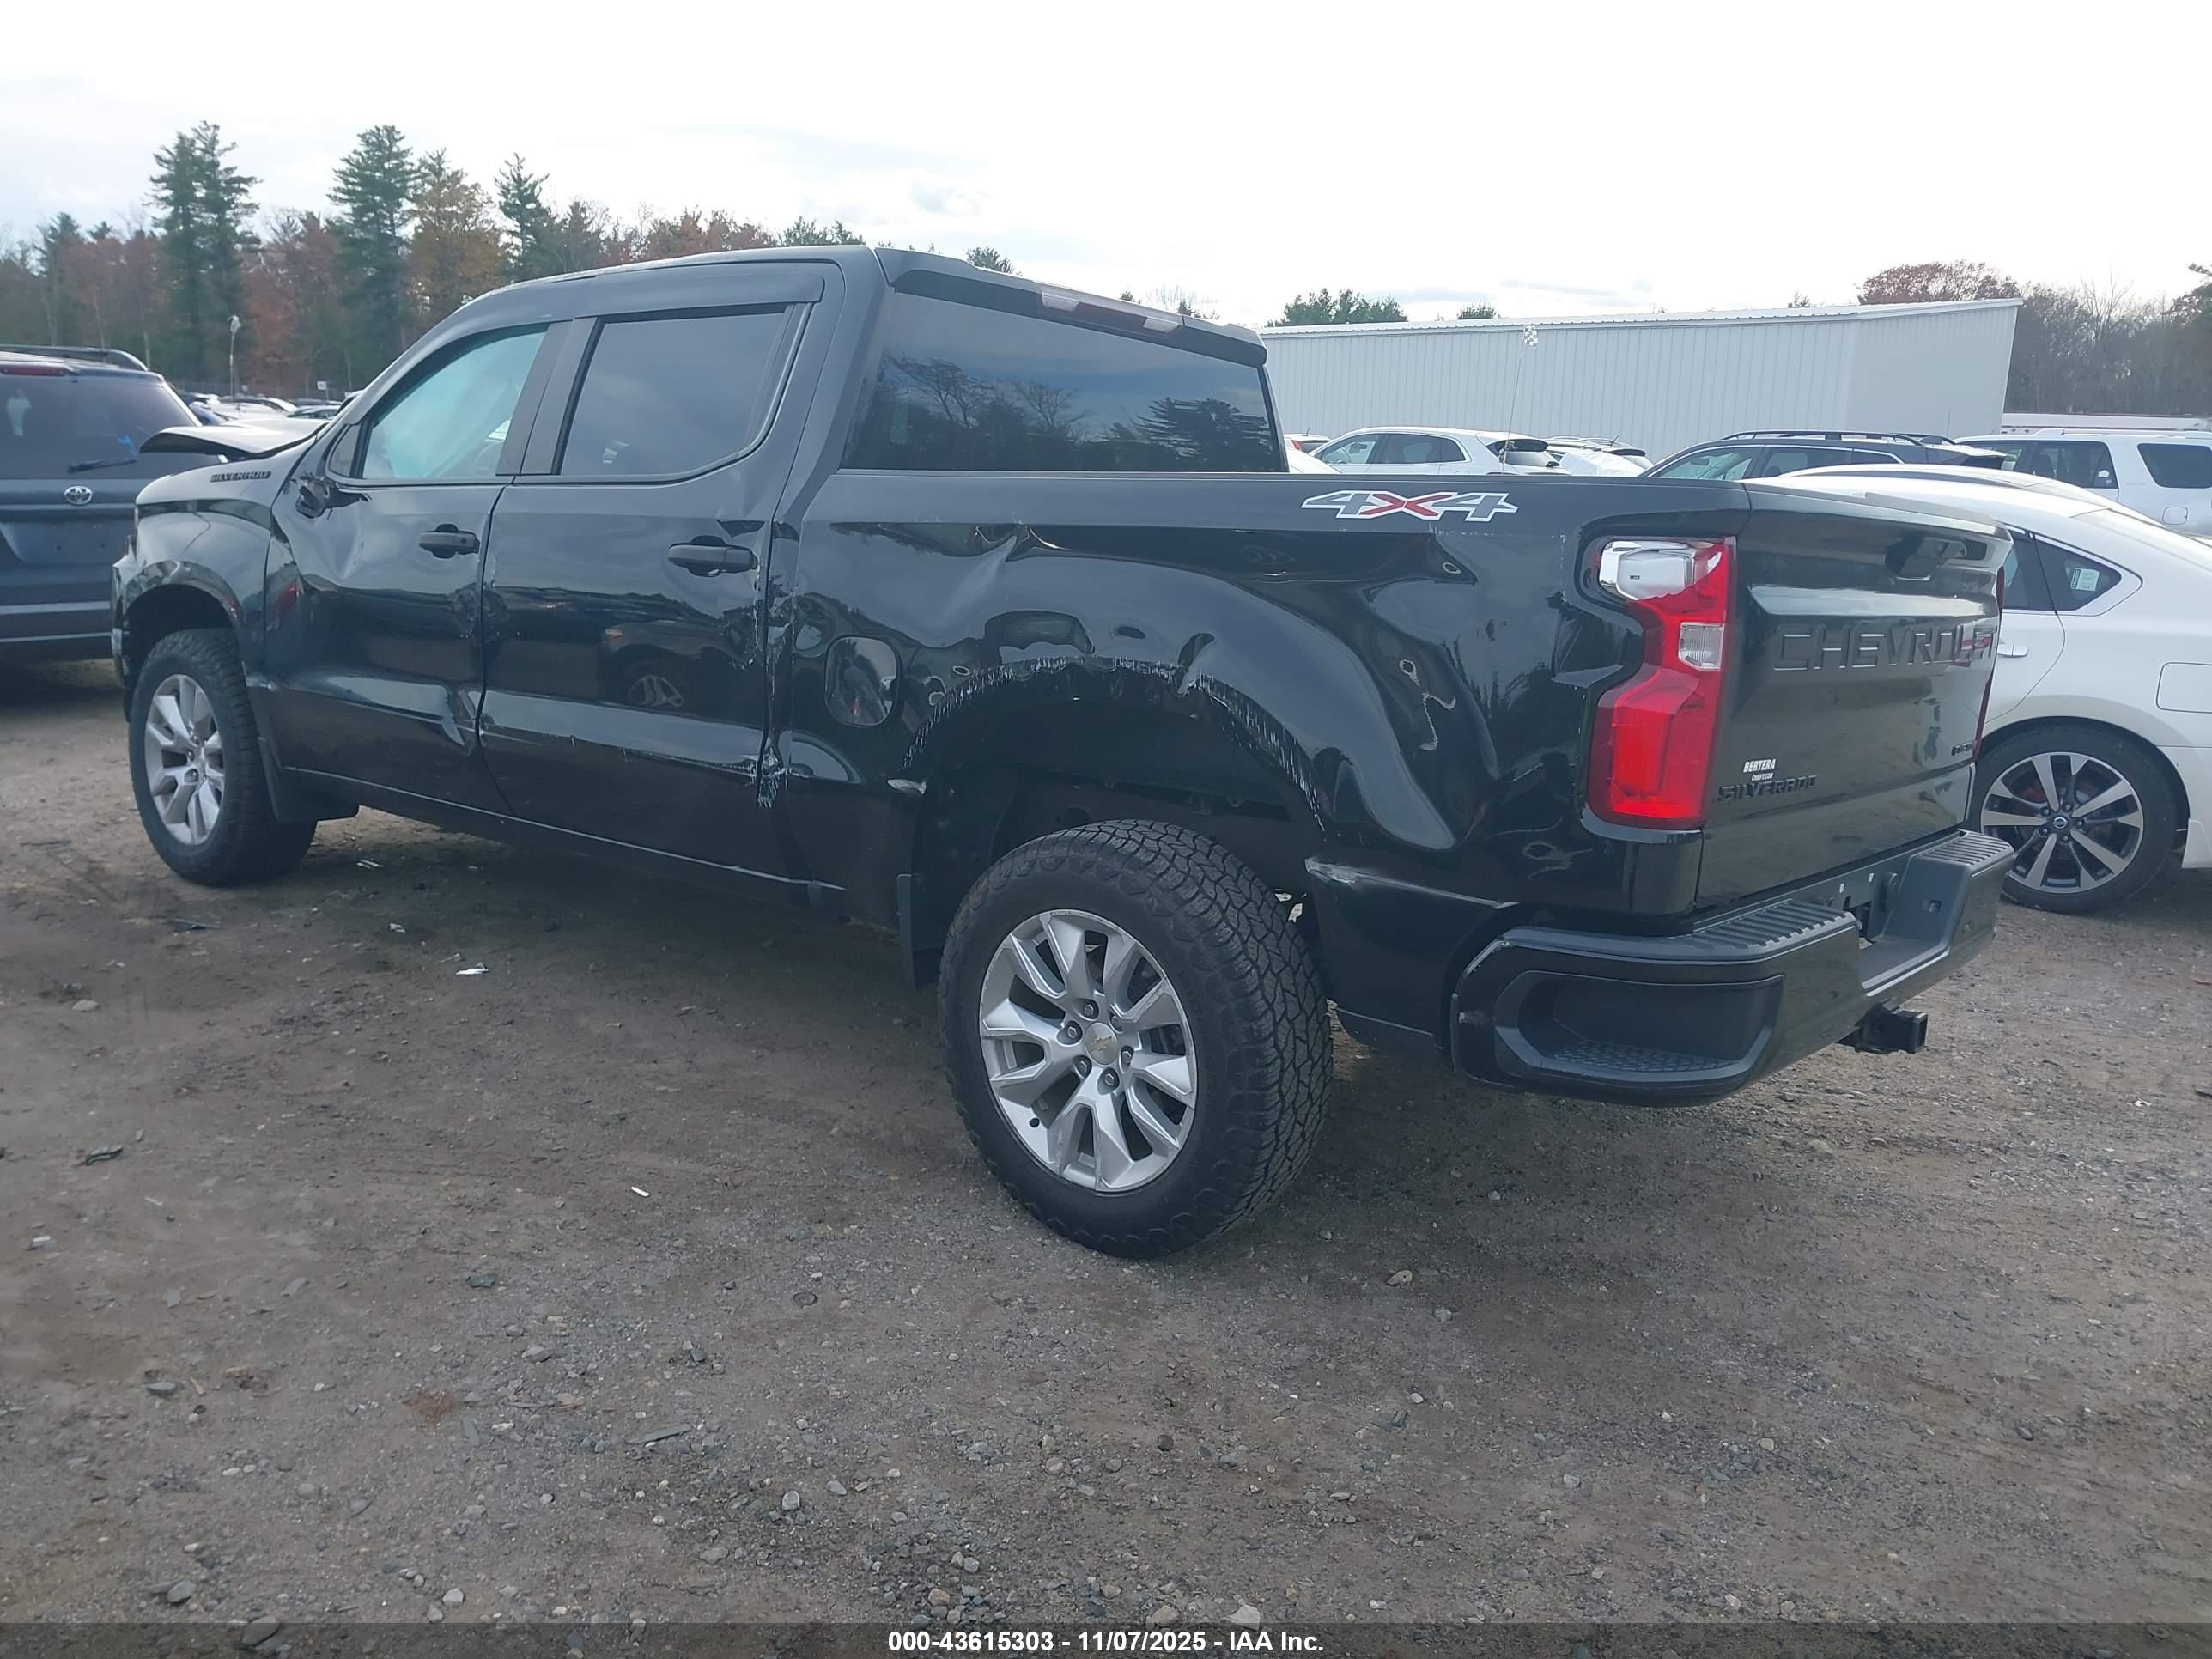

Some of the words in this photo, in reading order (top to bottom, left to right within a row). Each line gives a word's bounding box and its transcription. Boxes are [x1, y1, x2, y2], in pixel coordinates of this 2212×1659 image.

[1773, 623, 1998, 672] CHEVROLET
[1743, 758, 1776, 773] BERTERA
[1717, 775, 1818, 802] SILVERADO
